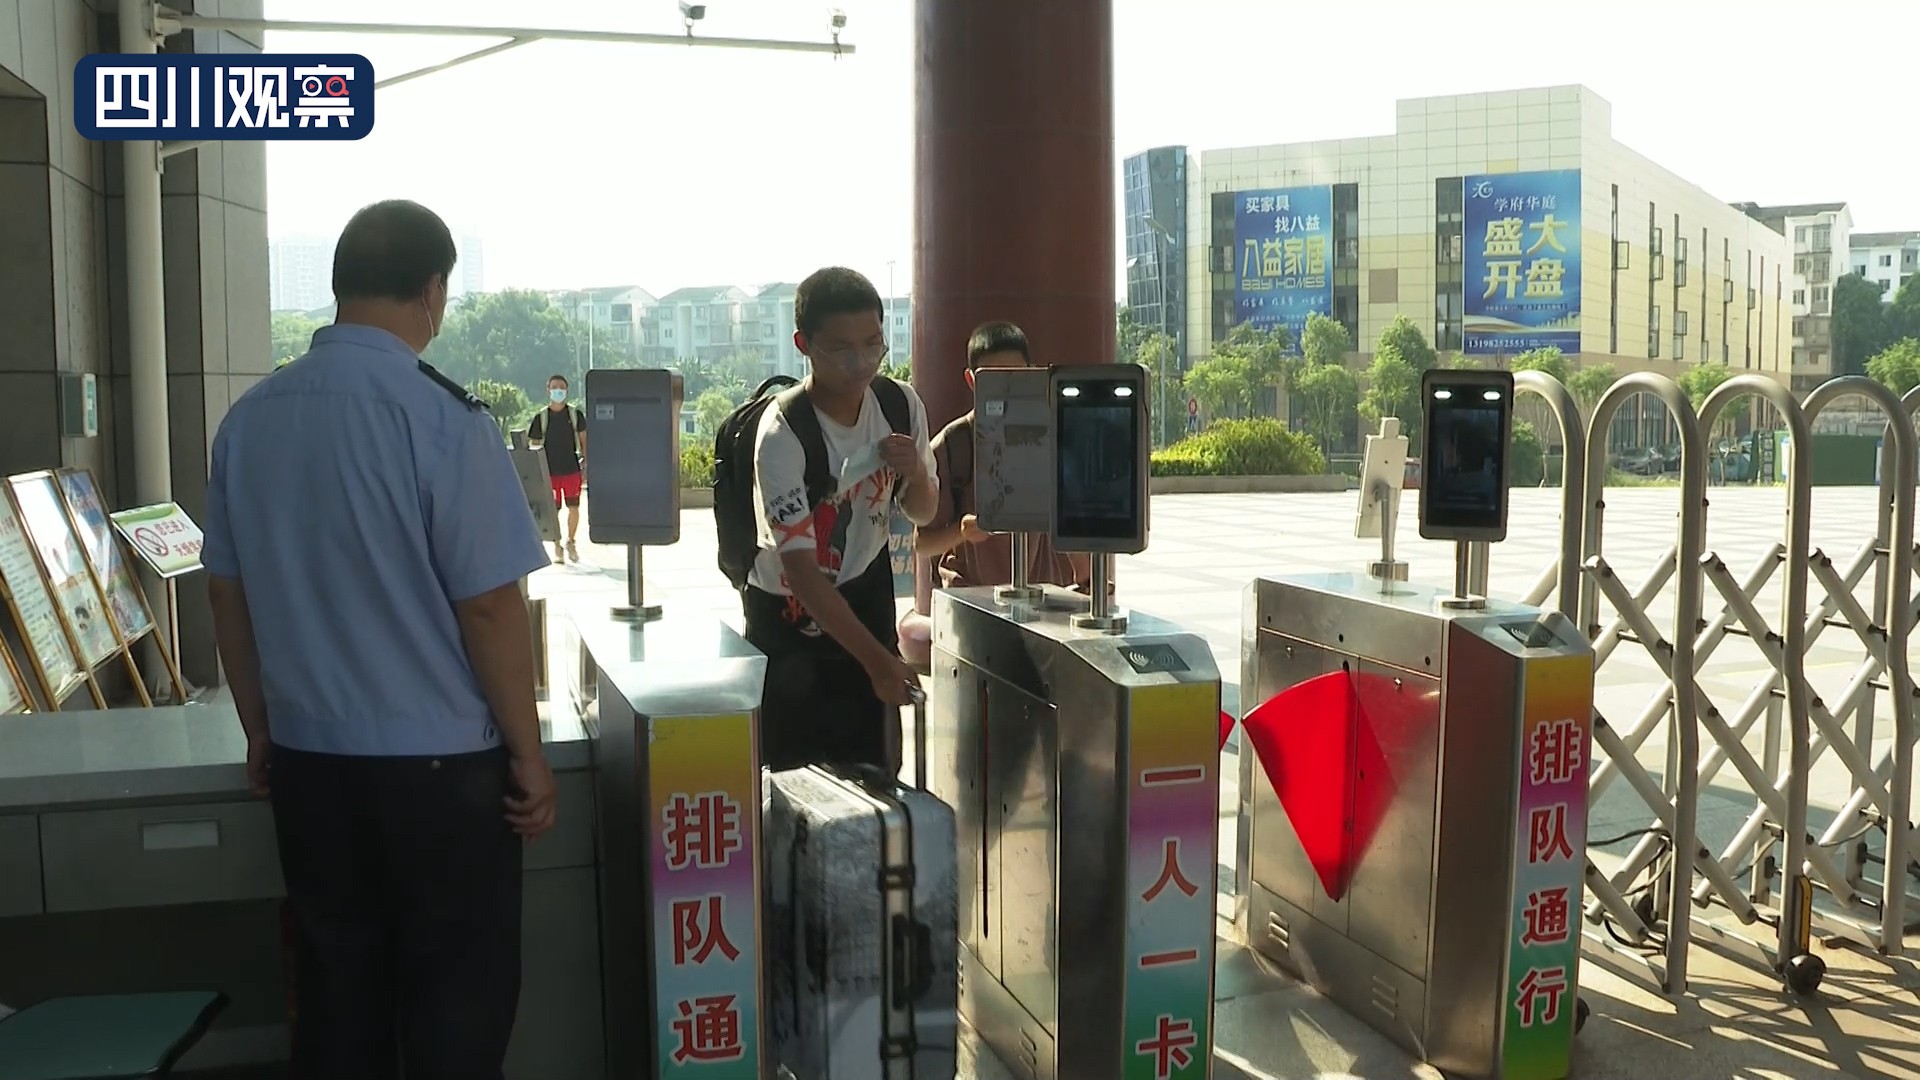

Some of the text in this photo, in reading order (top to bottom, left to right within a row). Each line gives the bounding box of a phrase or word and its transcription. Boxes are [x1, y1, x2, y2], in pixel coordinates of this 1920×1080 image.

[1244, 194, 1290, 214] 买家具
[1274, 214, 1320, 234] 找八益
[1493, 194, 1557, 213] 学府华庭
[1242, 235, 1325, 278] 八益家居
[1482, 213, 1568, 257] 盛大
[1275, 275, 1325, 289] HOMES
[1482, 257, 1566, 300] 开盘
[1516, 719, 1584, 1028] 排队通行
[666, 794, 745, 1063] 排队通
[1138, 766, 1205, 1079] 一人一卡
